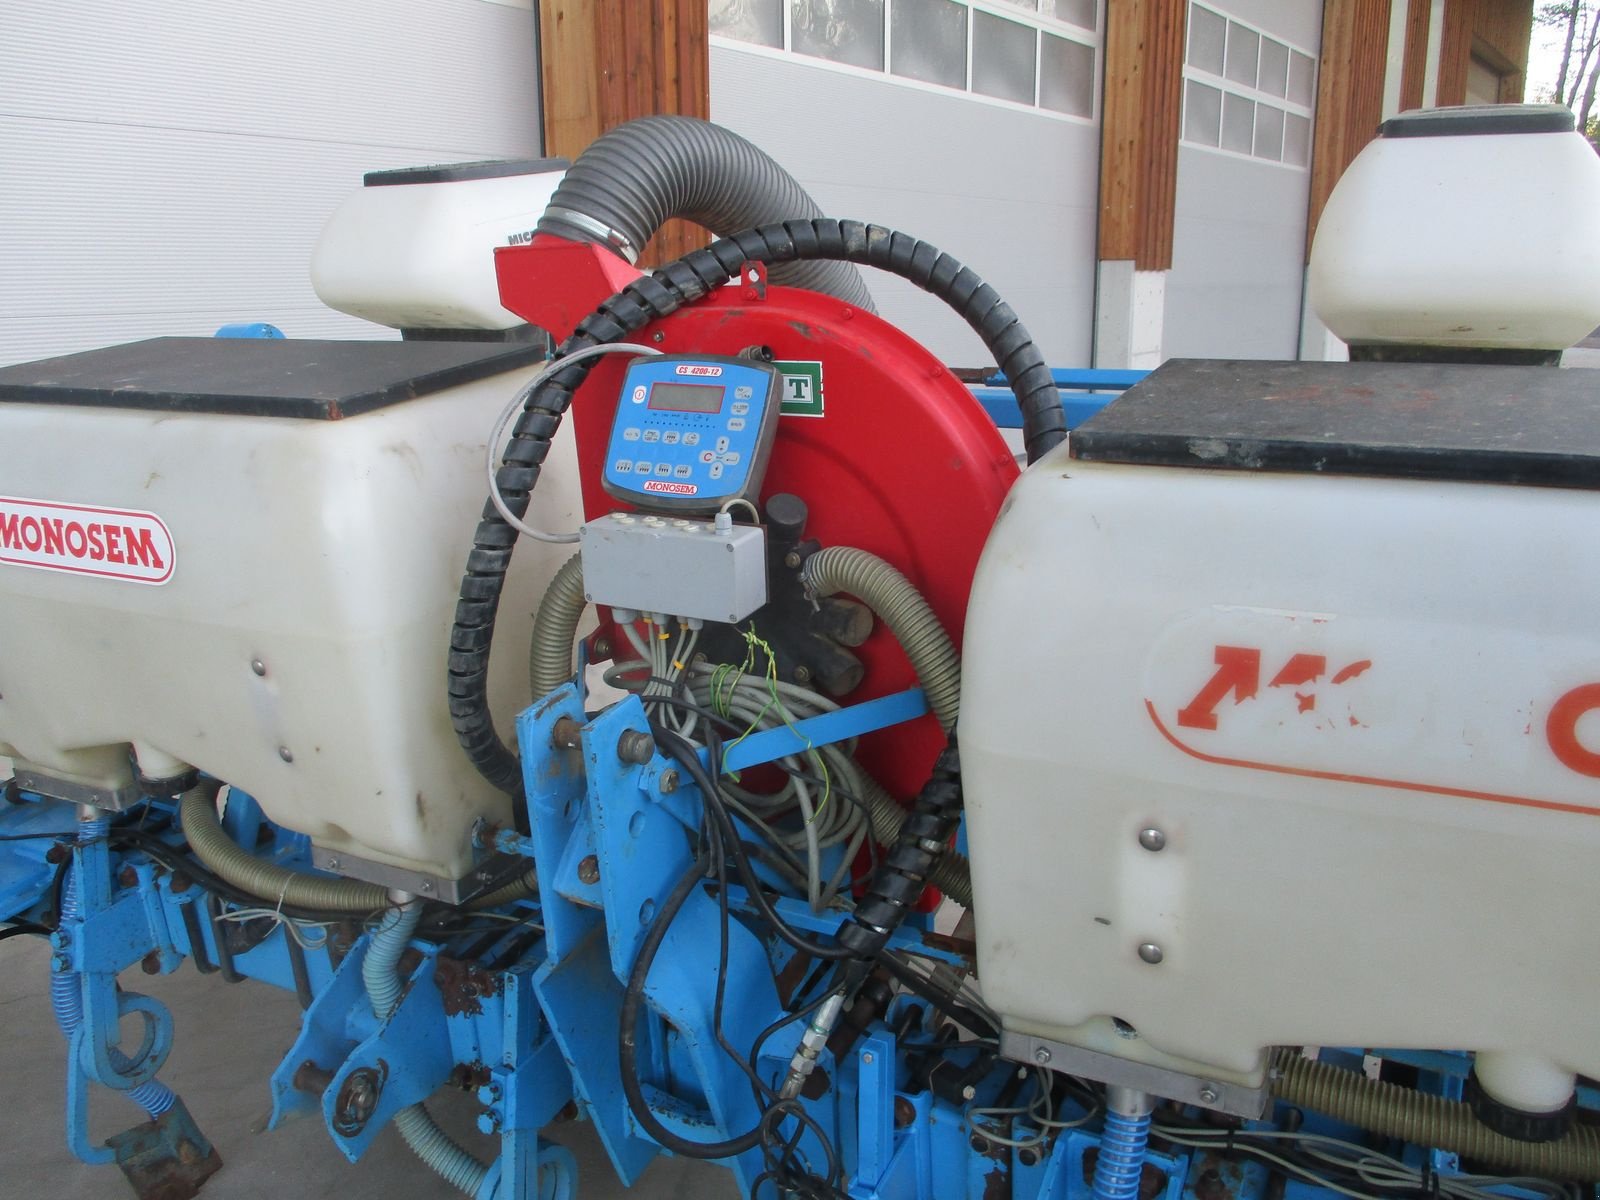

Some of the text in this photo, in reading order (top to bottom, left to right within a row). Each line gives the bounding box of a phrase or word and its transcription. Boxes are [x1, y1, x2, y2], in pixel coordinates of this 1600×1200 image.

[507, 231, 533, 245] MIC
[678, 366, 720, 375] CS 4200-12
[646, 482, 695, 494] MONOSEM
[0, 512, 164, 569] MONOSEM
